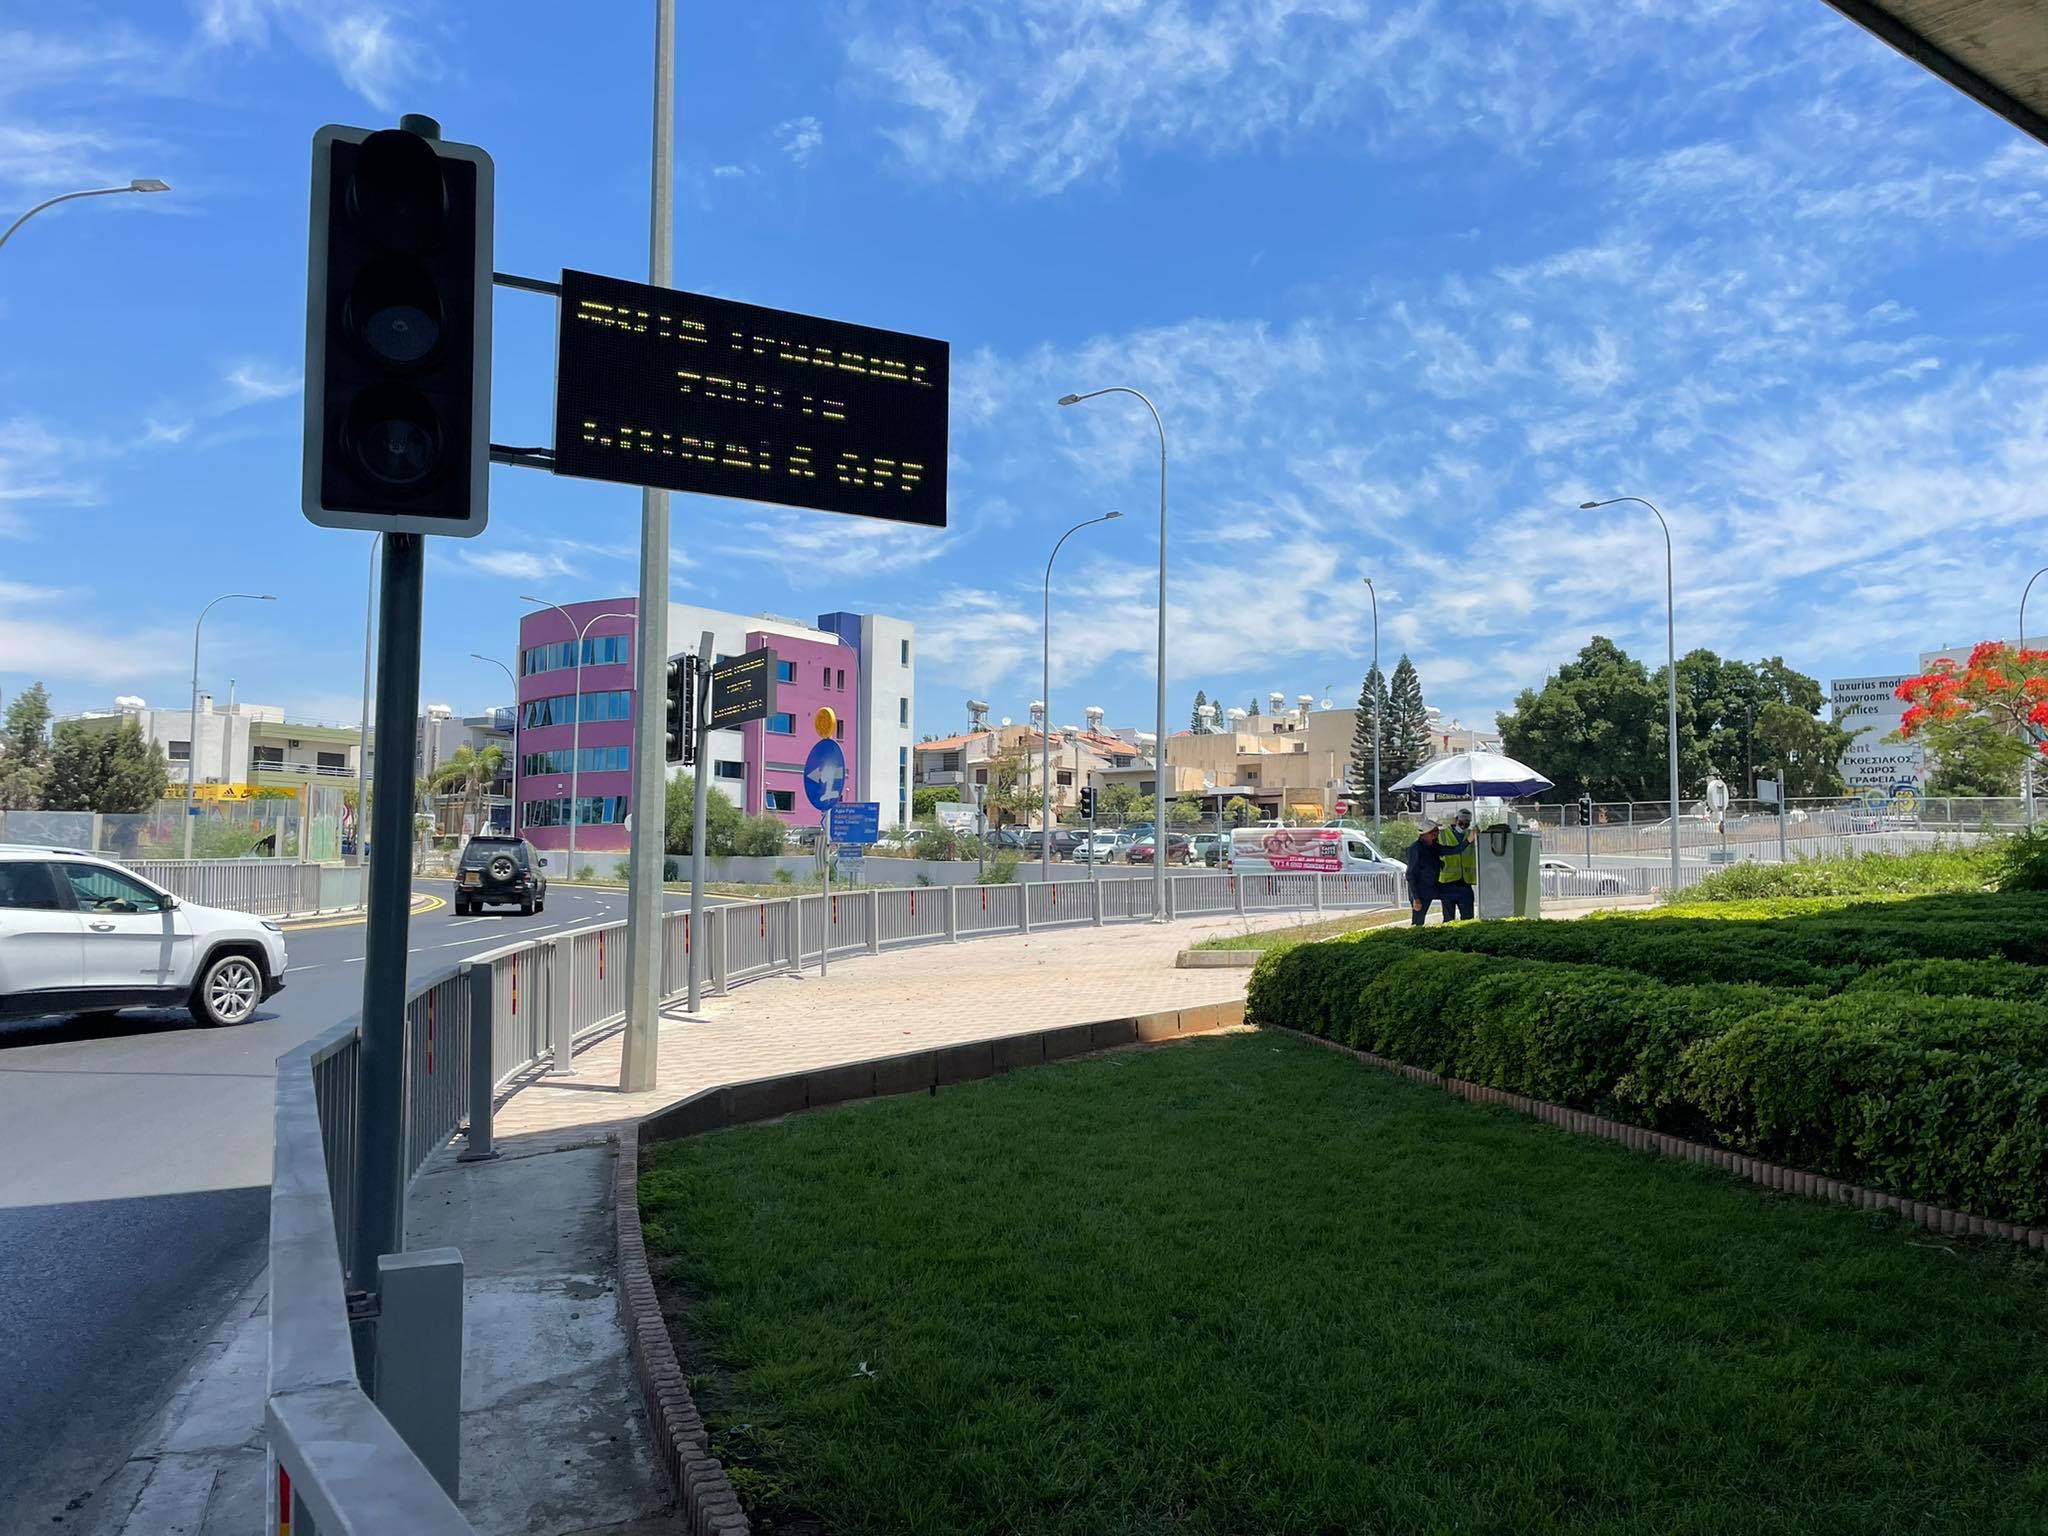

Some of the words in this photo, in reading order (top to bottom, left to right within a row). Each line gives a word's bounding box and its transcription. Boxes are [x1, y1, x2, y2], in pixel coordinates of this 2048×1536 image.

[1833, 681, 1876, 691] Luxurius
[1834, 693, 1890, 703] showrooms
[1834, 707, 1841, 715] &
[1846, 705, 1879, 715] ffices
[1843, 756, 1912, 765] ΕΚΘΕΣΙΑΚΟΣ
[1859, 766, 1897, 774] ΧΩΡΟΣ
[1849, 775, 1896, 784] ΓΡΑΦΕΙΑ
